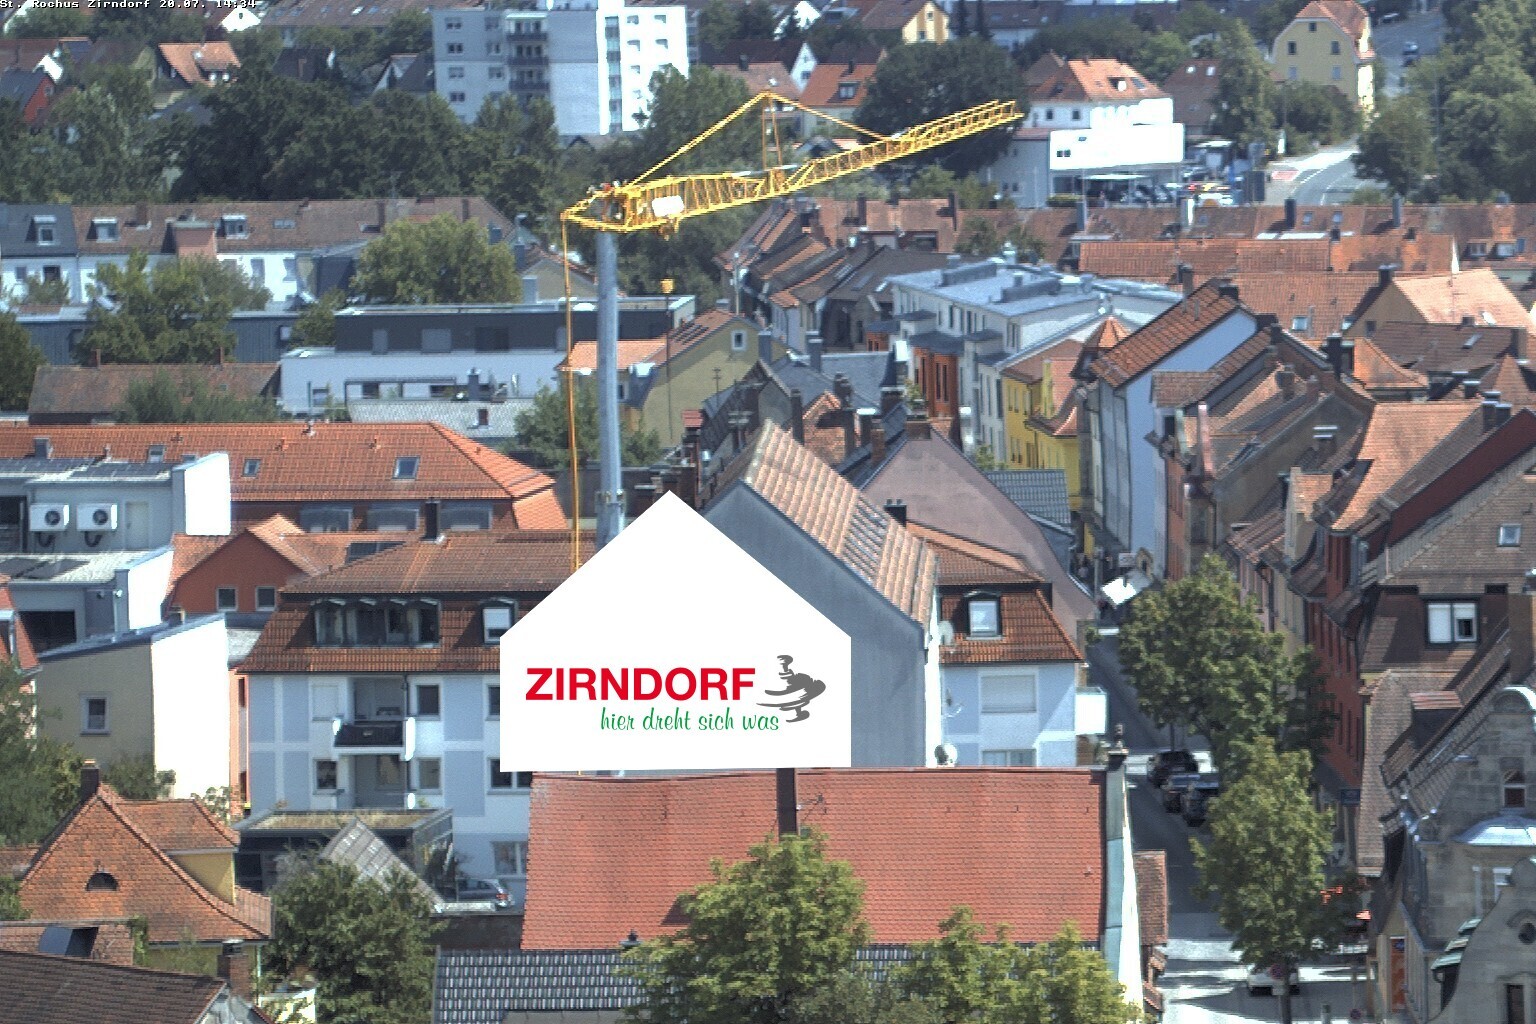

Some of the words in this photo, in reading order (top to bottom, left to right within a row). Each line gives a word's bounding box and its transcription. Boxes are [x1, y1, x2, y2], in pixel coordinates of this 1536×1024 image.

[525, 667, 756, 701] ZIRNDORF
[600, 707, 634, 731] hier
[643, 708, 690, 731] dreht
[698, 707, 734, 731] sich
[742, 714, 780, 731] was
